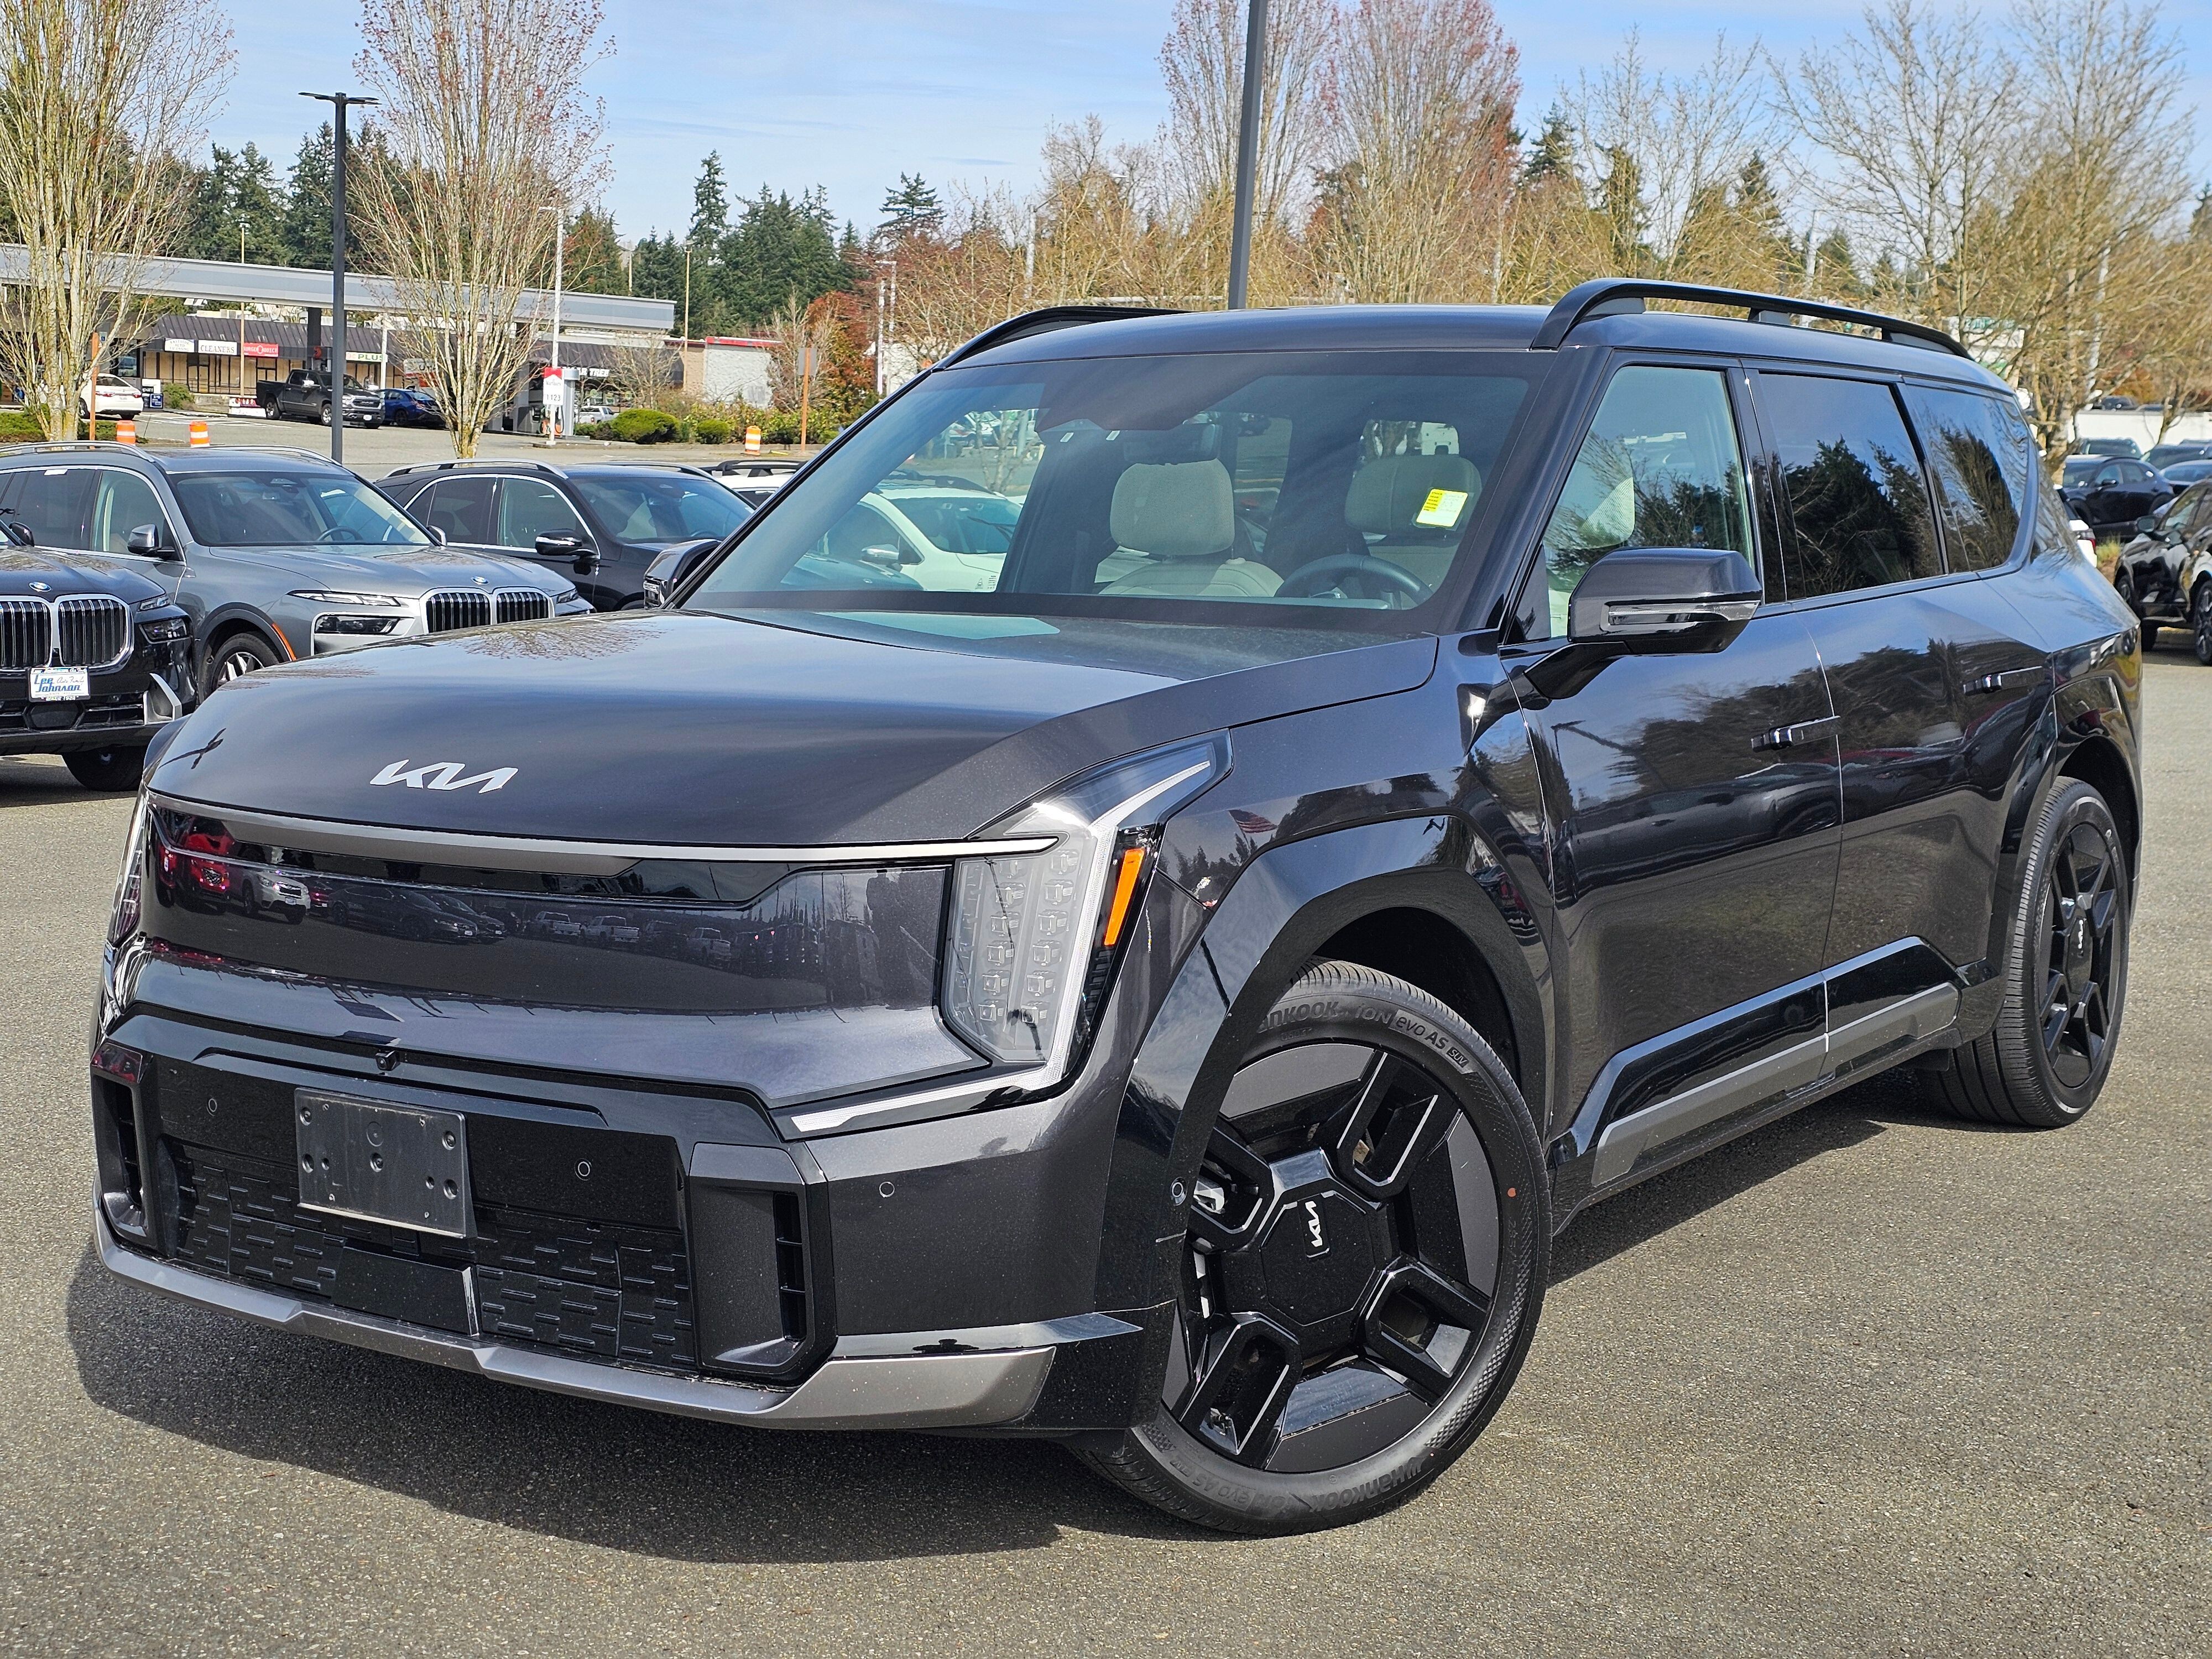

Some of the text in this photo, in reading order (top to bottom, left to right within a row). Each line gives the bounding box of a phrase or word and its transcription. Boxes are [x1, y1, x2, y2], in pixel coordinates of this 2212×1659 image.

[200, 345, 235, 353] CLEANERS
[34, 674, 55, 685] Lee
[35, 680, 81, 692] Johnson
[369, 759, 519, 794] KIA
[1425, 1030, 1447, 1049] AS
[1447, 1049, 1469, 1068] SUV
